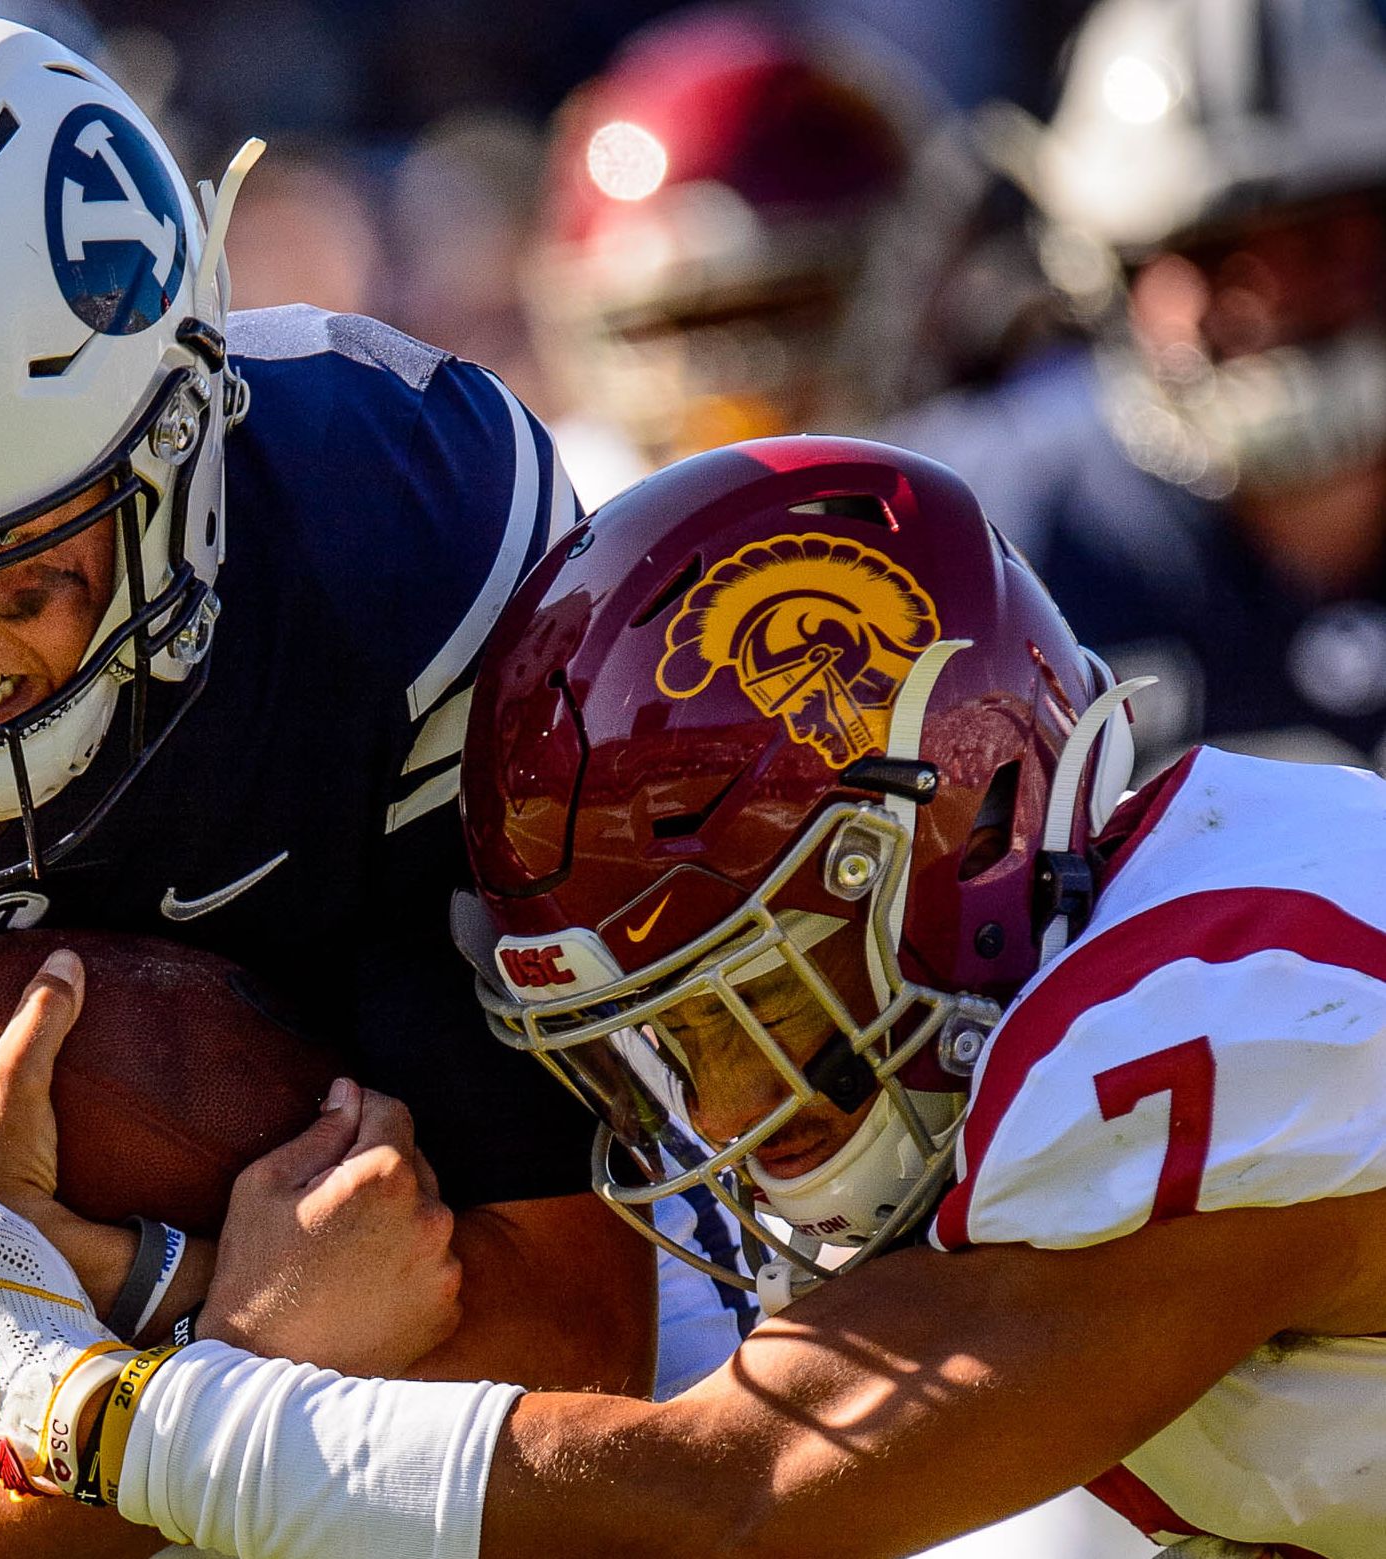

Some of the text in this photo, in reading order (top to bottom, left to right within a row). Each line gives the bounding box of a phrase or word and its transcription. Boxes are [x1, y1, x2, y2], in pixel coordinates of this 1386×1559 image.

[62, 119, 176, 288] Y
[499, 944, 577, 988] USC
[1093, 1036, 1217, 1225] 7
[817, 1214, 851, 1234] ON!
[115, 1357, 150, 1411] 2016
[51, 1418, 70, 1454] SC
